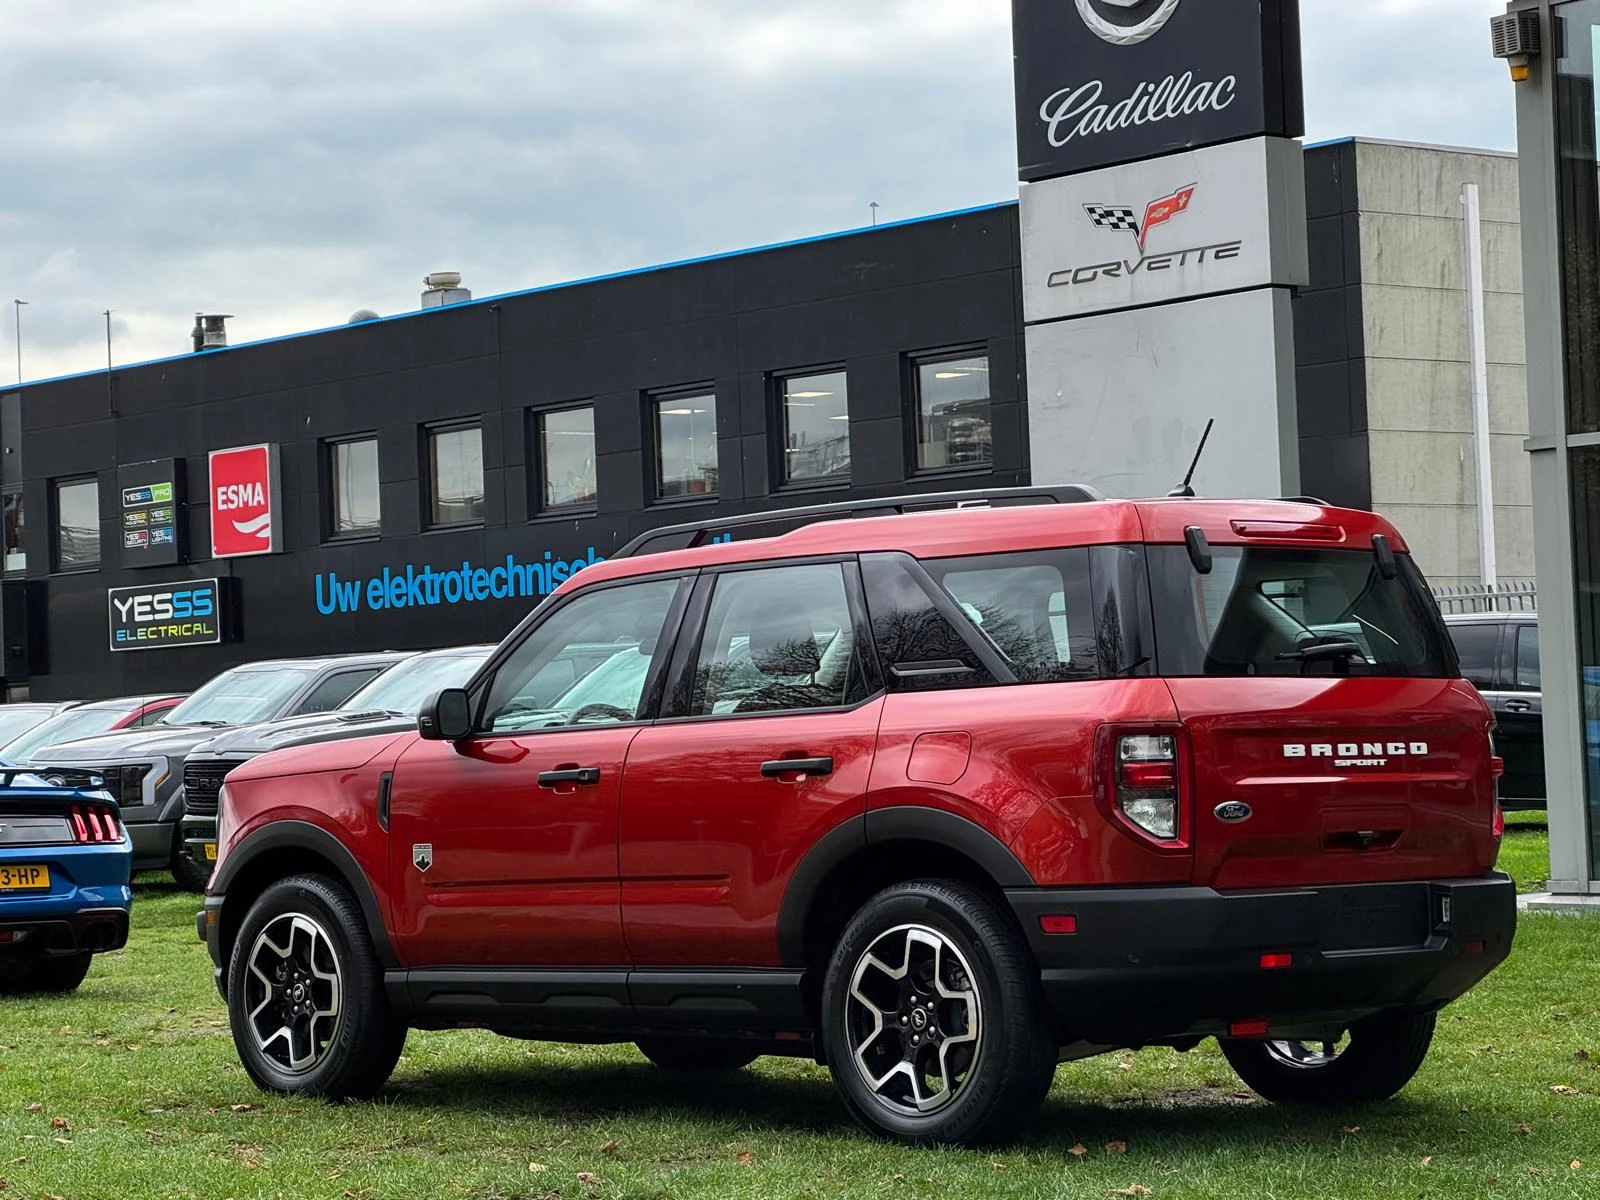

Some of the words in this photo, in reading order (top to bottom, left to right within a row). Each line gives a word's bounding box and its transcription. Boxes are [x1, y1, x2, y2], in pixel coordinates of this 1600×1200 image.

[1039, 71, 1236, 147] Cadillac
[1047, 240, 1242, 288] CORVETTE
[217, 482, 265, 510] ESMA
[114, 589, 213, 623] YESSS
[315, 572, 361, 614] Uw
[116, 623, 213, 641] ELECTRICAL
[1283, 742, 1428, 757] BRONCO
[1223, 806, 1246, 818] Ford
